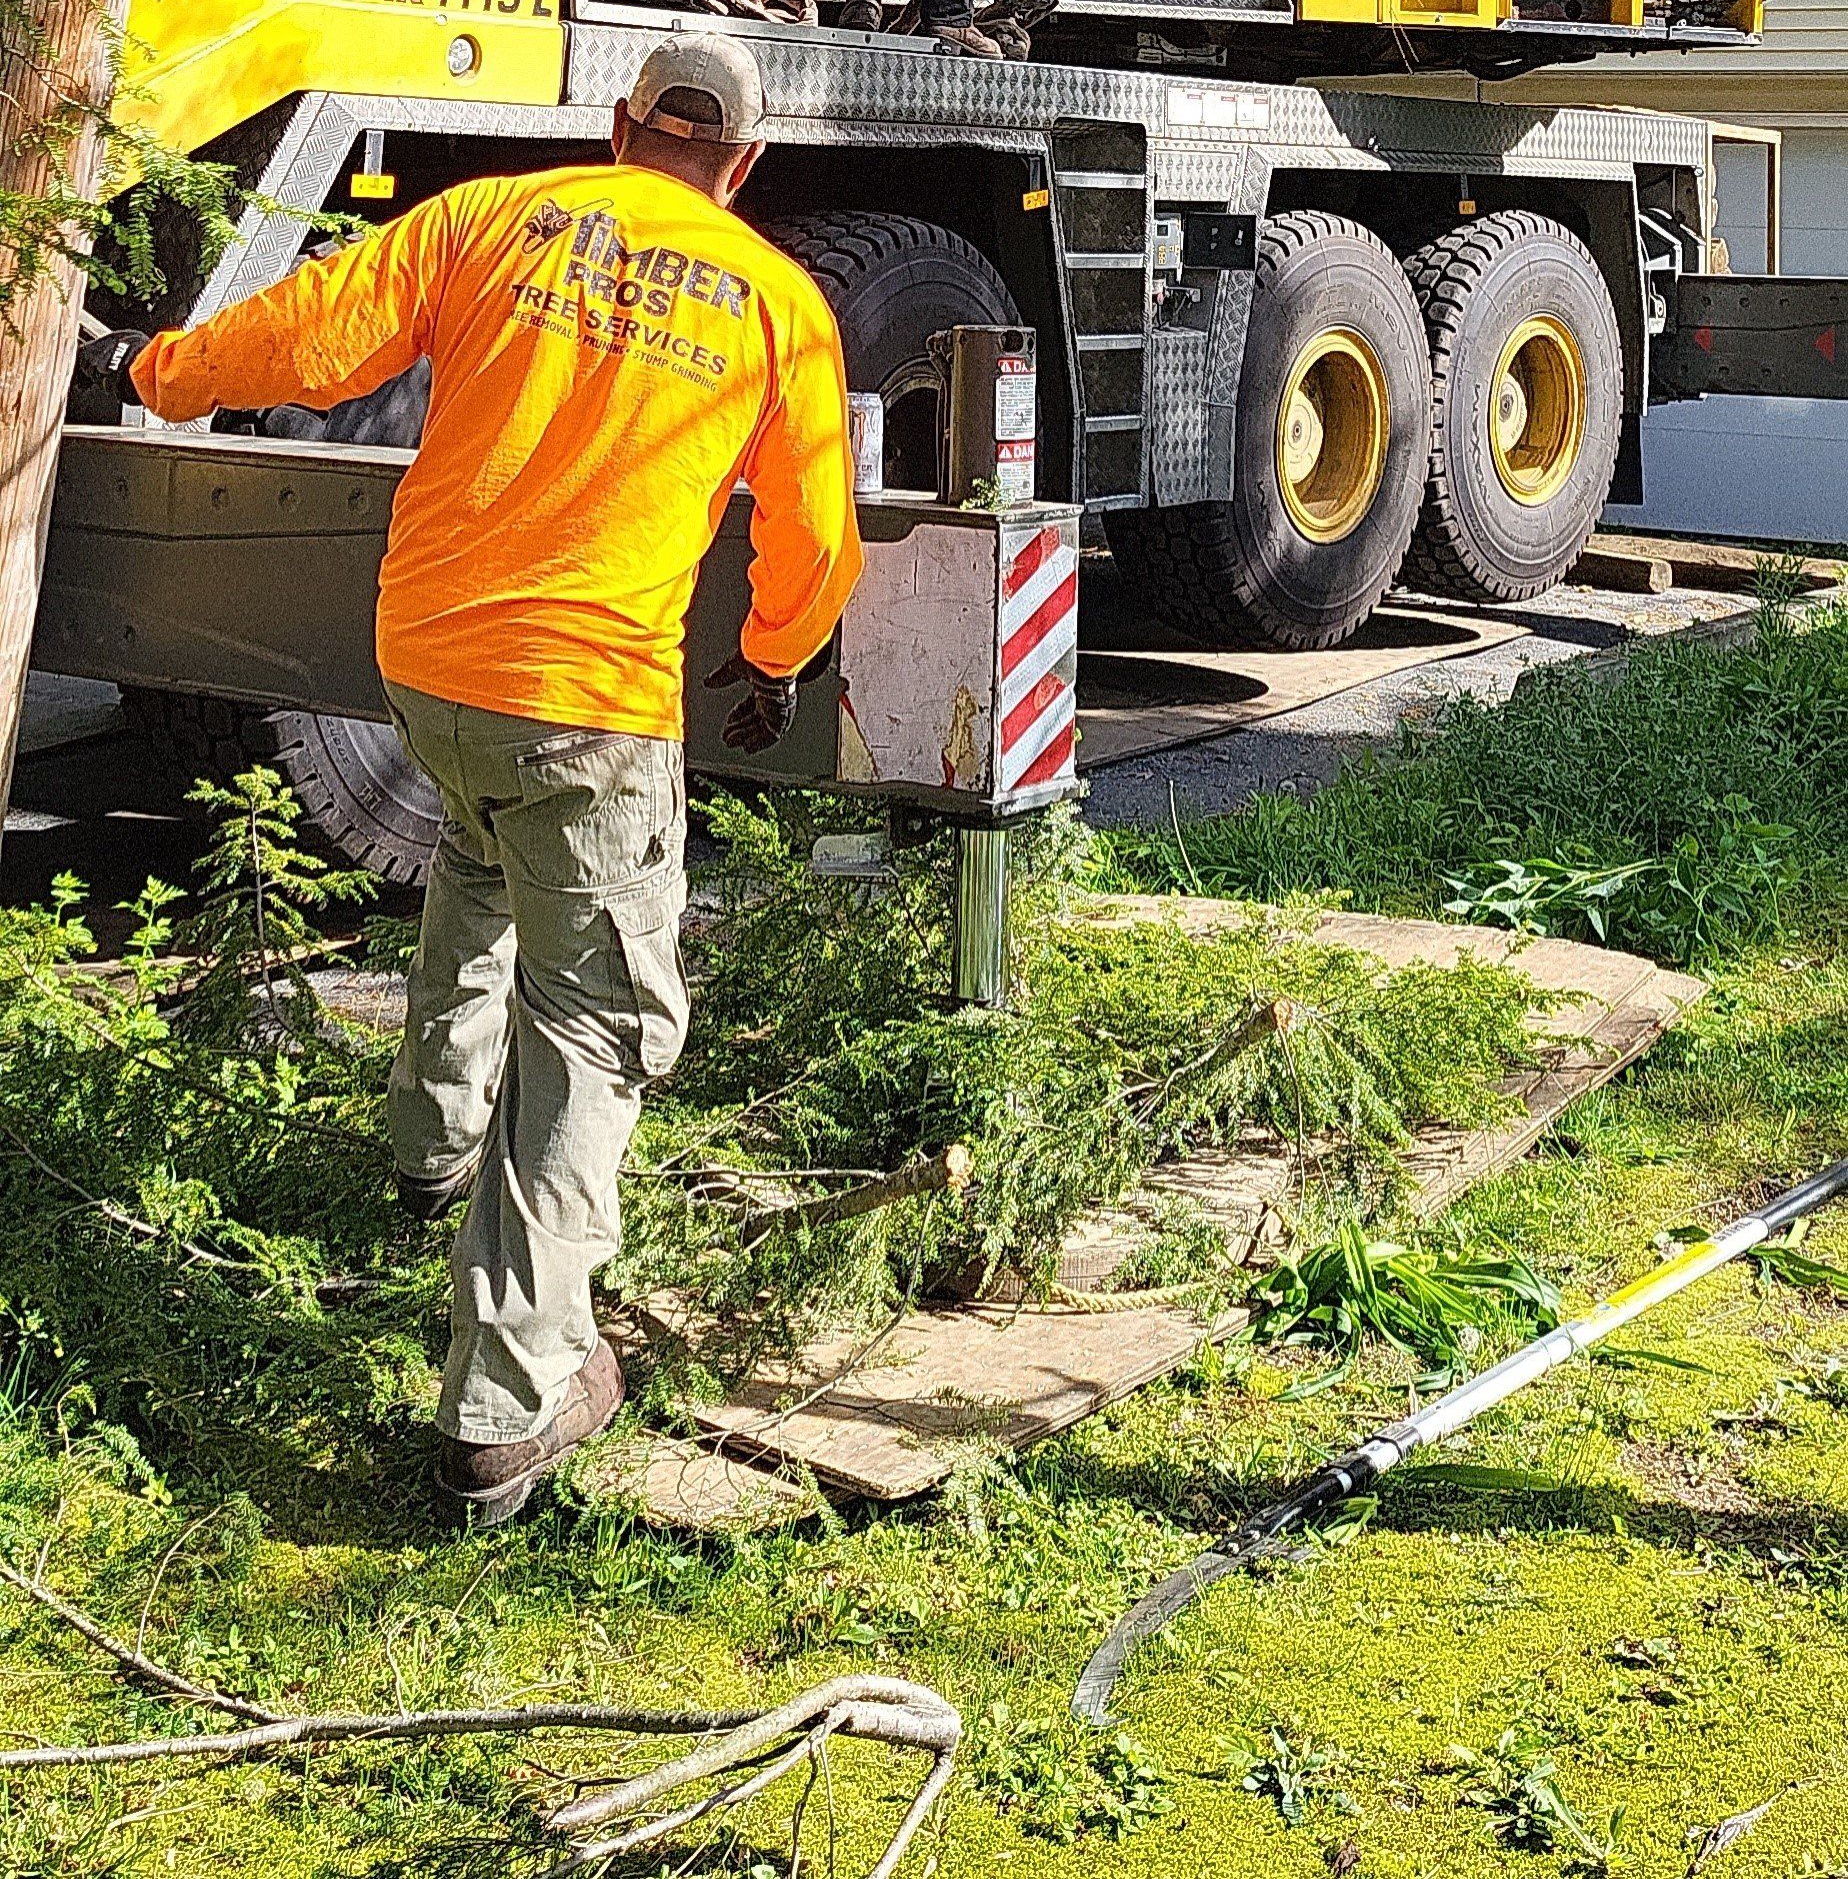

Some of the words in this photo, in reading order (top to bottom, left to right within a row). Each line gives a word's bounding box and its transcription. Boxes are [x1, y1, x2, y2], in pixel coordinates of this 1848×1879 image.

[562, 259, 671, 317] PROS
[571, 211, 751, 320] TIMBER
[511, 284, 579, 322] TREE
[585, 309, 727, 375] SERVICES
[529, 314, 573, 339] REMOVAL
[582, 334, 625, 355] PRUNING
[633, 349, 668, 368] STUMP
[671, 363, 717, 392] GRINDING
